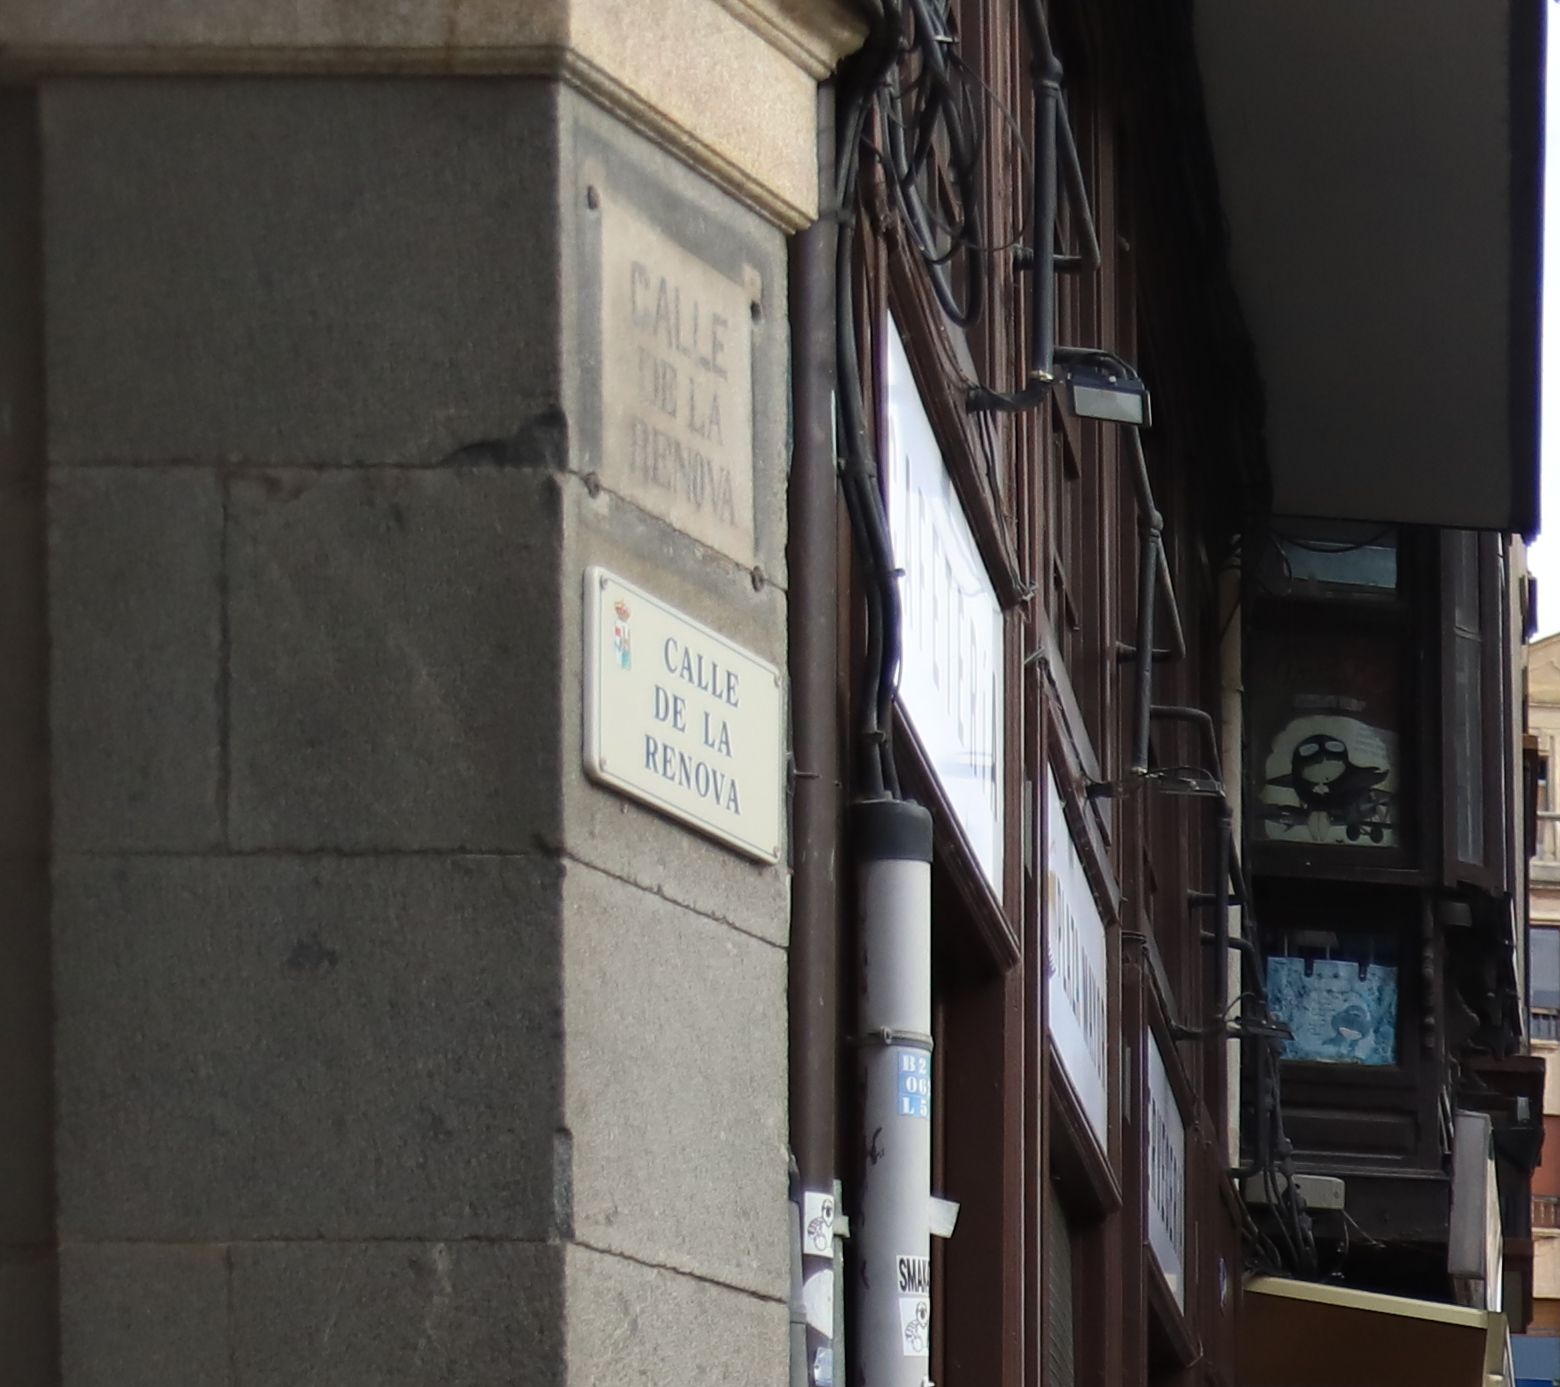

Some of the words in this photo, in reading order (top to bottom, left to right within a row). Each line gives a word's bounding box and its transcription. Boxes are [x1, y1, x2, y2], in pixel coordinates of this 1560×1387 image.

[628, 259, 728, 381] CALLE
[637, 344, 677, 416] DE
[687, 381, 724, 446] LA
[629, 419, 736, 528] RENOVA
[664, 634, 740, 711] CALLE
[654, 684, 687, 732] DE
[703, 711, 733, 760] LA
[644, 732, 741, 818] RENOVA
